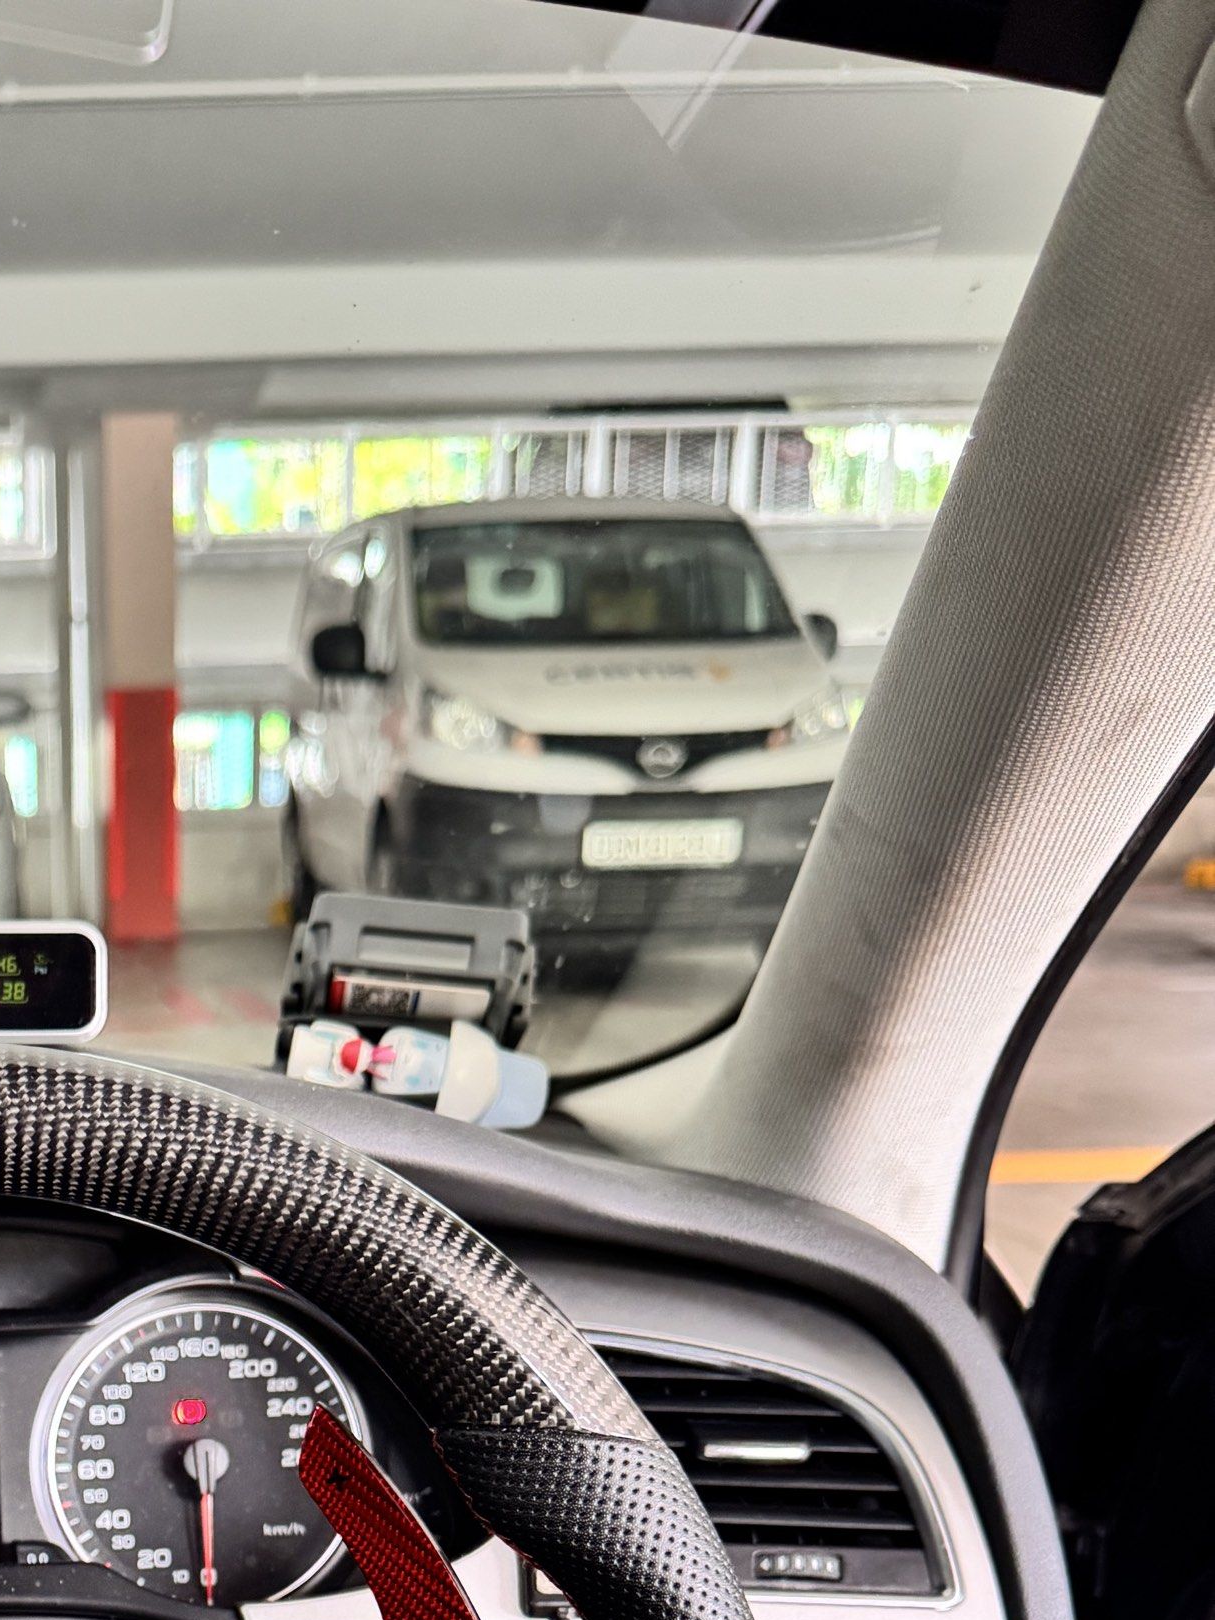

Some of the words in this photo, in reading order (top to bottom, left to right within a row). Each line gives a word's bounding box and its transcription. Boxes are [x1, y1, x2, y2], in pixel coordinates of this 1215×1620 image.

[2, 981, 26, 1001] 38
[122, 1361, 166, 1383] 120
[228, 1358, 278, 1379] 200
[89, 1404, 125, 1426] 80
[266, 1396, 314, 1418] 240
[77, 1458, 115, 1480] 60
[95, 1508, 131, 1530] 40
[263, 1521, 306, 1537] km/h
[137, 1548, 172, 1569] 20
